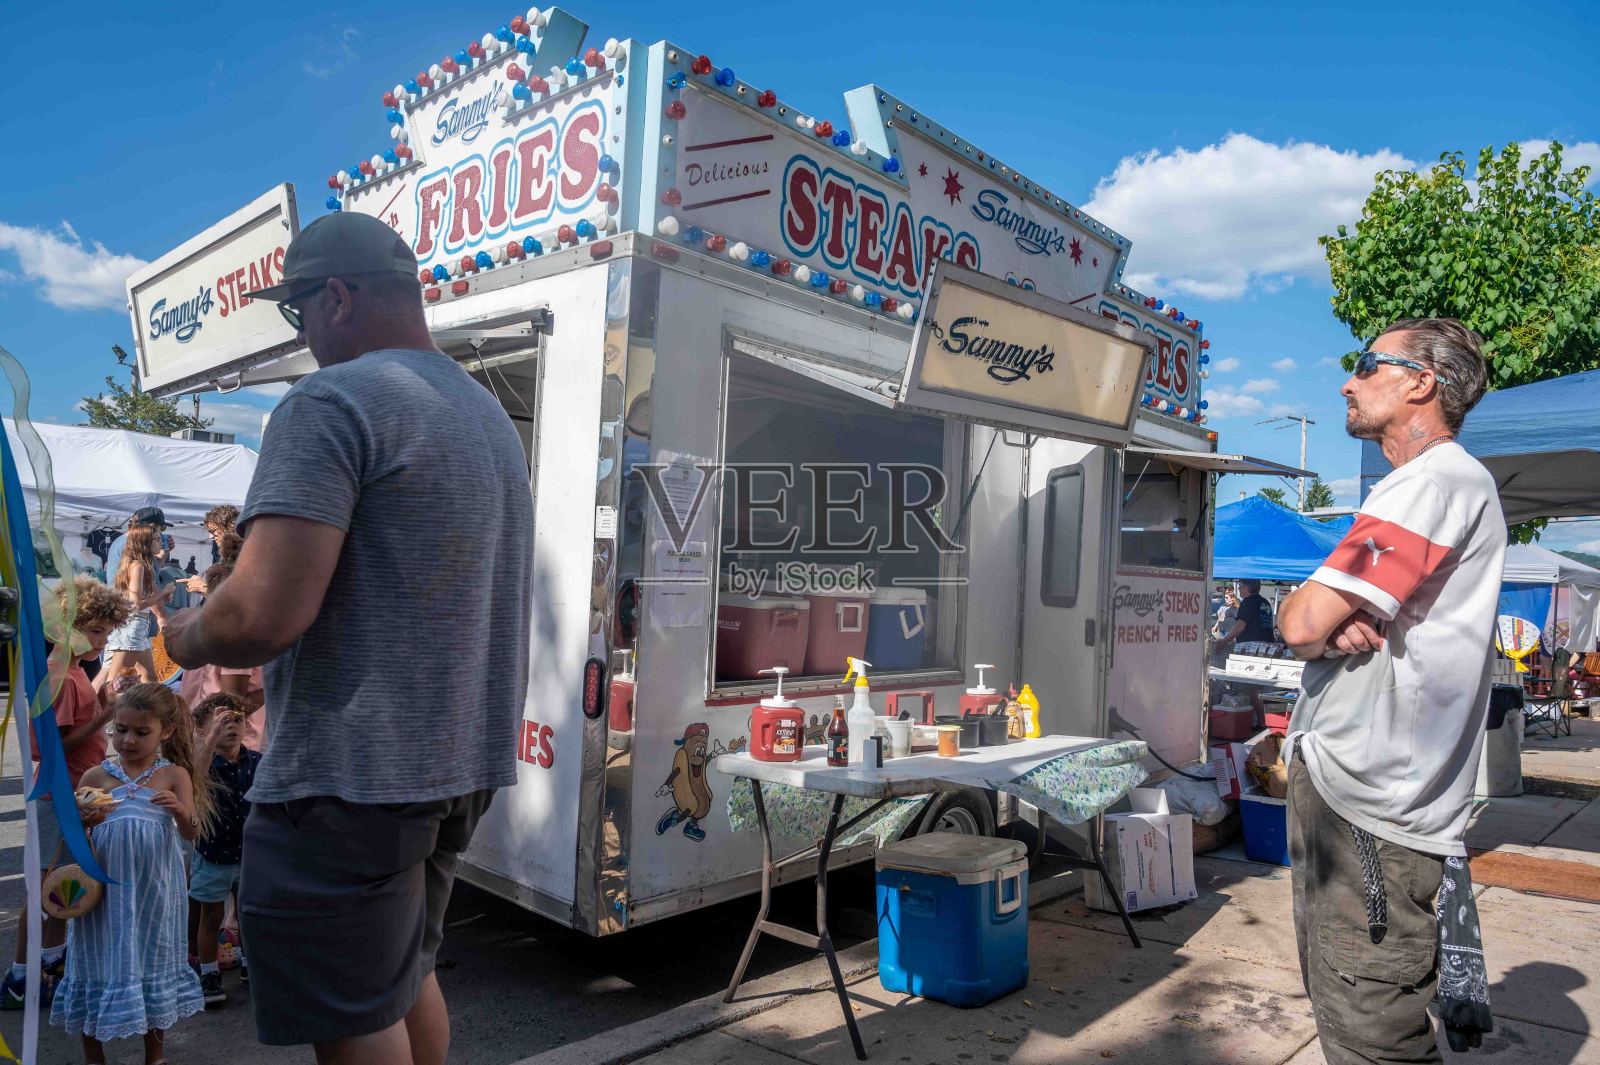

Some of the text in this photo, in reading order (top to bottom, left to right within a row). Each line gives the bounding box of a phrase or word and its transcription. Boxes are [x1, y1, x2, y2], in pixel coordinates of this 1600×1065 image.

[414, 110, 601, 257] FRIES
[685, 158, 769, 186] Delicious
[972, 189, 1066, 256] Sammy's
[150, 286, 214, 343] Sammy's
[940, 316, 1056, 385] Sammy's
[1113, 585, 1200, 617] Sammy's STEAKS
[1113, 624, 1198, 643] RENCH FRIES
[517, 719, 554, 769] IES
